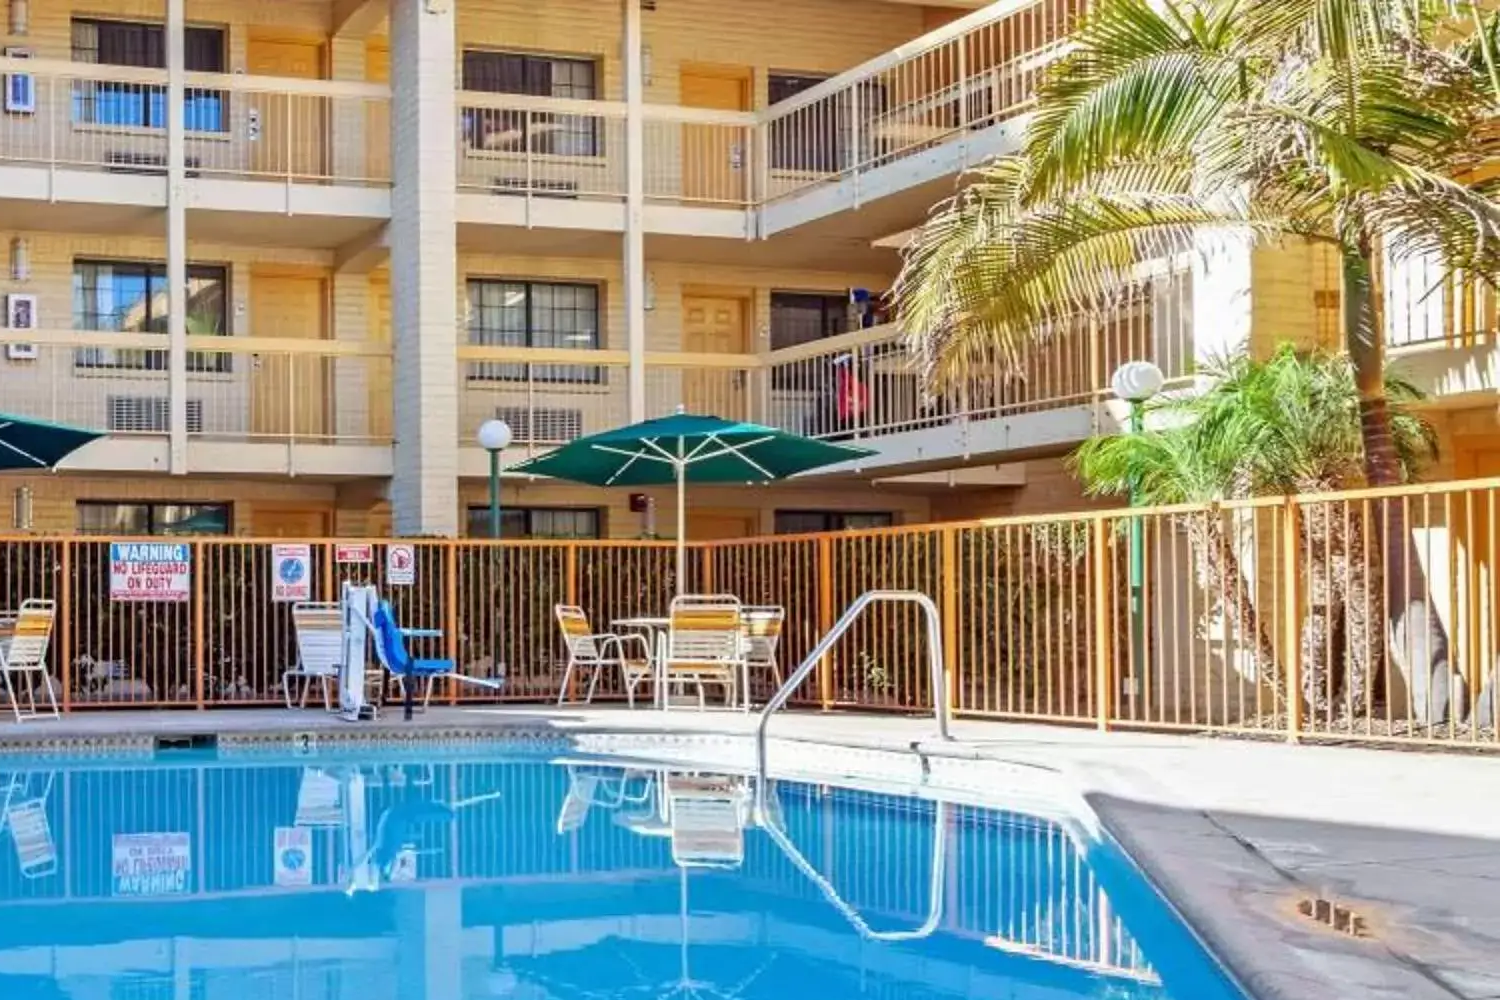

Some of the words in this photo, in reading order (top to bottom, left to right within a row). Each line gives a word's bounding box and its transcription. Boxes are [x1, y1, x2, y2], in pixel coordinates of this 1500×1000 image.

[117, 544, 183, 561] WARNING
[114, 562, 127, 574] NO
[132, 562, 187, 574] LIFEGUARD
[127, 577, 141, 589] ON
[146, 577, 173, 589] DUTY
